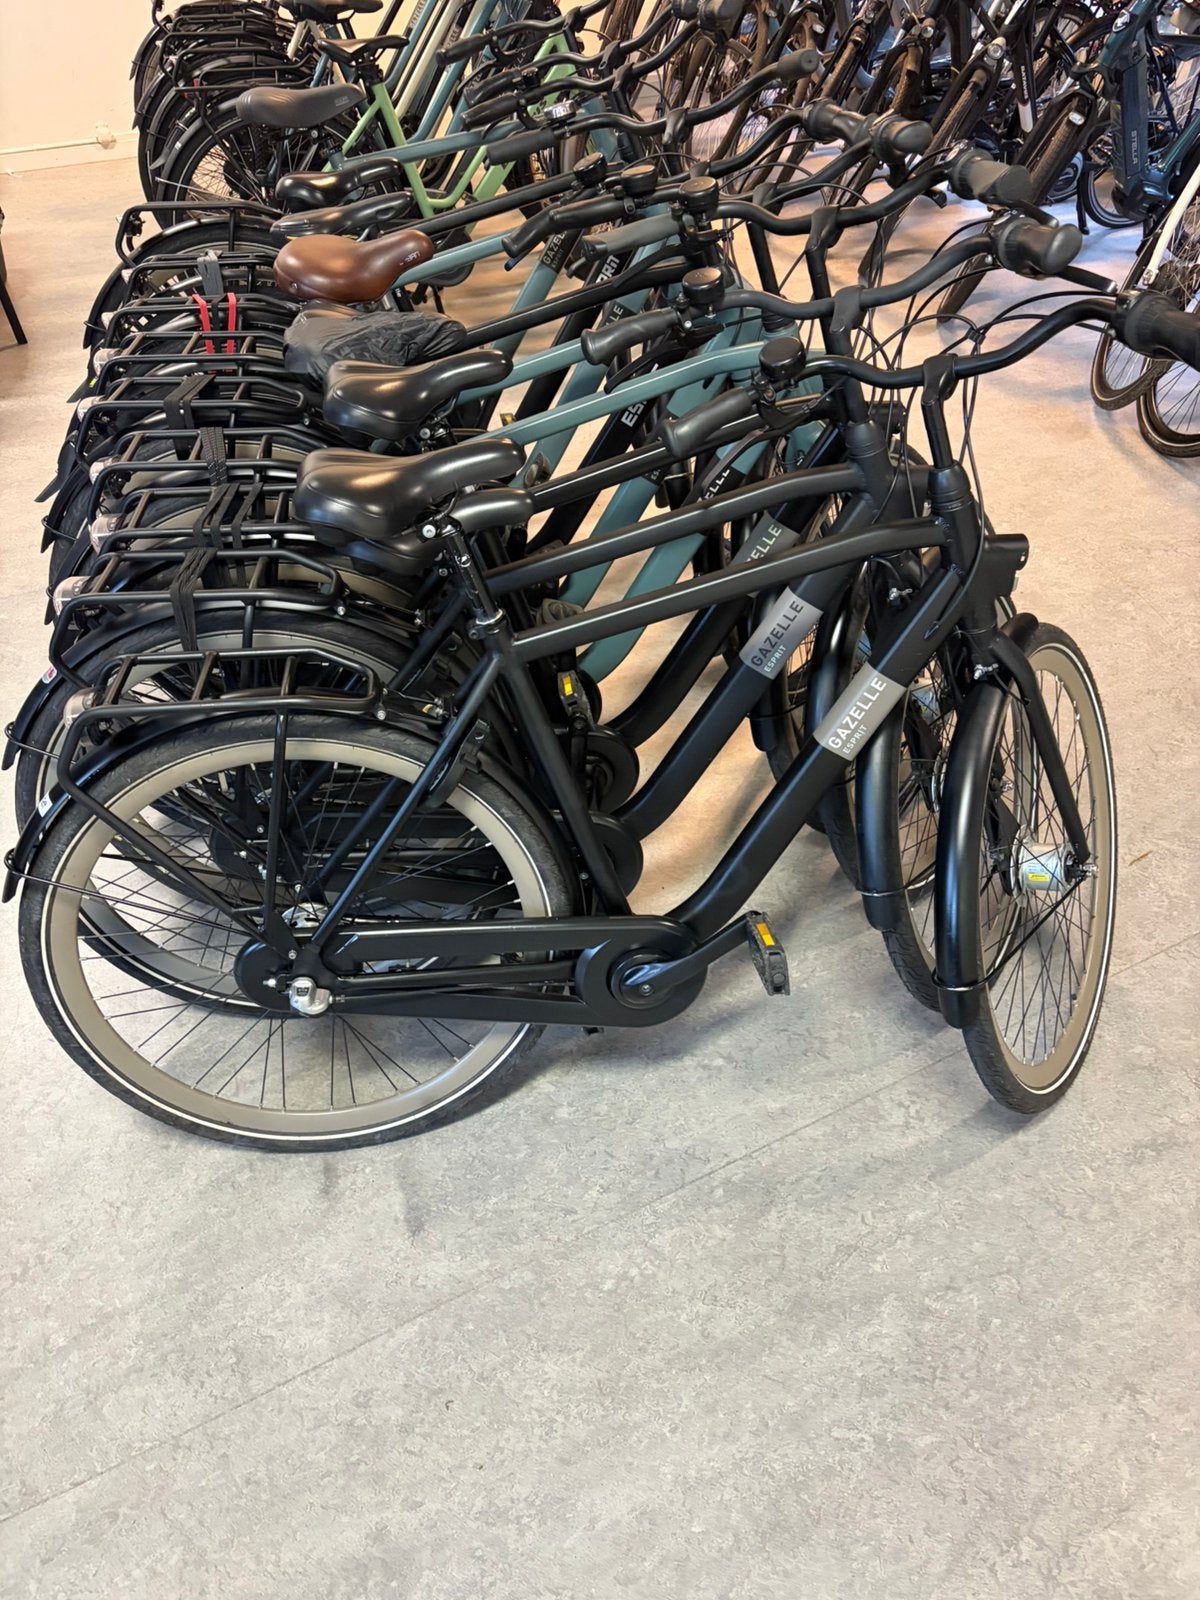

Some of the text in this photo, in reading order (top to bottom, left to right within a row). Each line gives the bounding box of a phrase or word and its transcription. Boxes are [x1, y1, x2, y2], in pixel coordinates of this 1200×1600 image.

[1020, 65, 1029, 99] BATAVUS
[543, 230, 567, 264] GAZEL
[747, 524, 782, 561] ELLE
[751, 601, 804, 666] GAZELLE
[764, 645, 787, 672] ESPRIT
[828, 677, 887, 749] GAZELLE
[843, 724, 867, 754] ESPRIT
